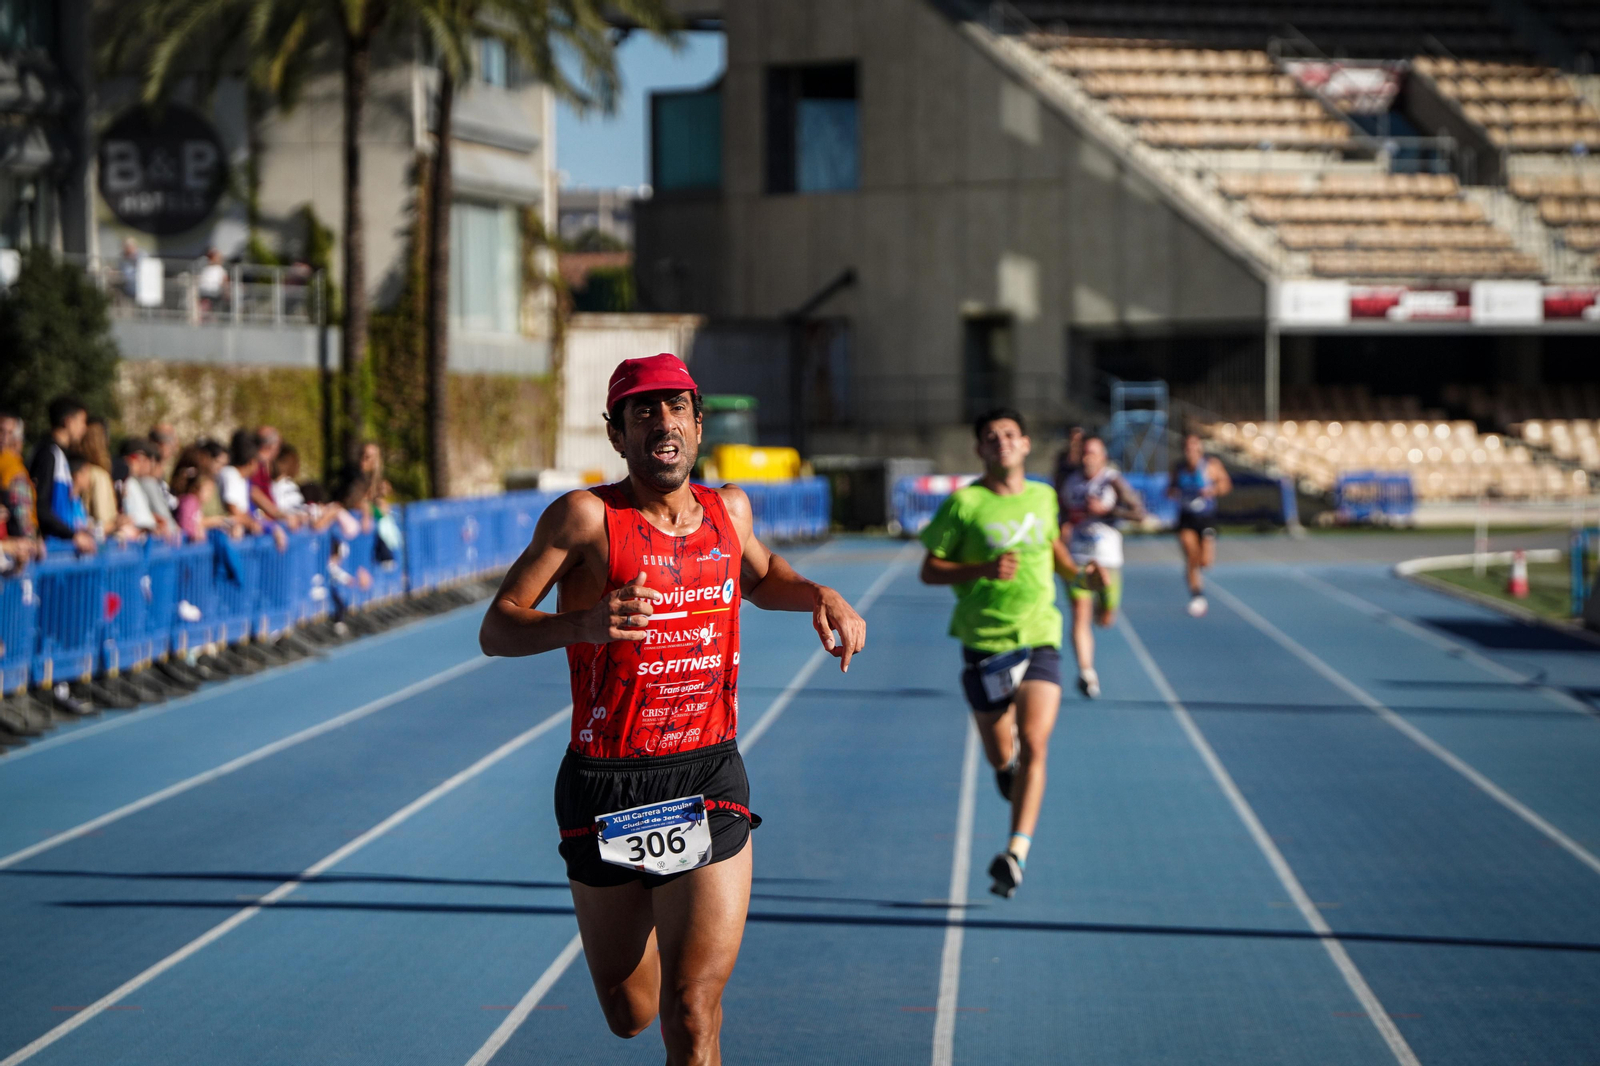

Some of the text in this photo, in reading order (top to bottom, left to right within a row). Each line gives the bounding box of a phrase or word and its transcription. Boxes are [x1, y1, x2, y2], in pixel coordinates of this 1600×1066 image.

[643, 555, 674, 566] GOBIK
[661, 736, 700, 749] ORTEDIA
[612, 801, 693, 824] XLIII Carrera Popular
[622, 818, 650, 830] Ciudad
[626, 827, 686, 862] 306
